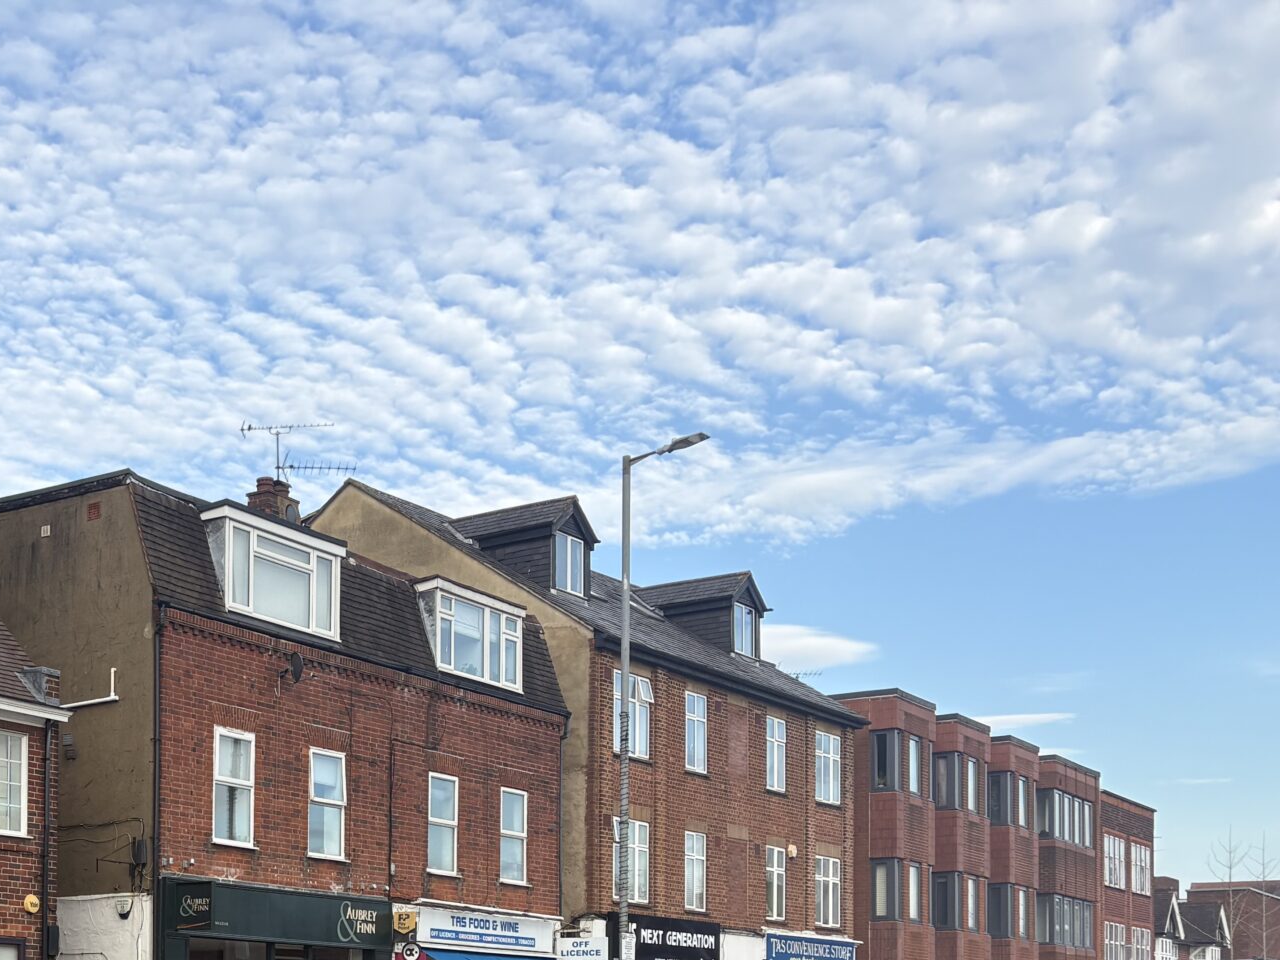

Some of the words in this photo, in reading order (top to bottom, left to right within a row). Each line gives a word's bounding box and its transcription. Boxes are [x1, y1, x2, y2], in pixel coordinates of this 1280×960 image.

[186, 897, 211, 905] AUBREY
[194, 904, 209, 912] FINN
[346, 906, 377, 922] AUBREY
[356, 921, 376, 934] FINN
[451, 915, 467, 928] TAS
[468, 917, 490, 931] FOOD
[492, 920, 498, 931] &
[500, 920, 519, 933] WINE
[640, 928, 664, 945] NEXT
[666, 931, 715, 949] GENERATION
[561, 949, 601, 957] LICENCE
[771, 938, 786, 957] TAS
[786, 940, 830, 958] CONVENIENCE
